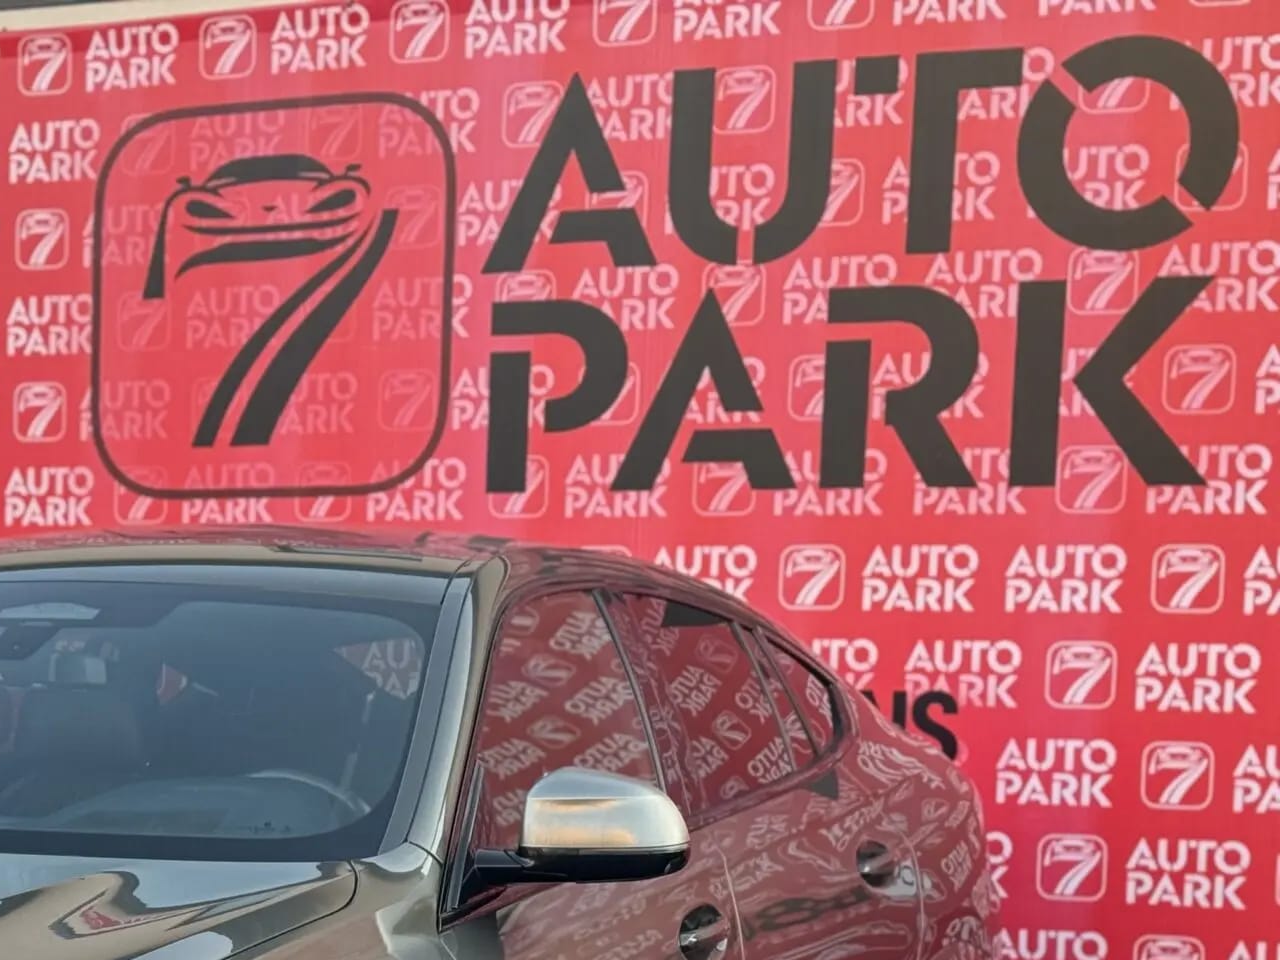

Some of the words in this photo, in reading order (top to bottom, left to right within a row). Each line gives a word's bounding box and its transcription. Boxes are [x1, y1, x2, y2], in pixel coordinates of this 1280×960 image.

[271, 4, 369, 42] AUTO
[464, 19, 567, 59] PARK
[673, 2, 780, 43] PARK
[85, 24, 178, 60] AUTO
[271, 36, 365, 73] PARK
[86, 55, 176, 92] PARK
[9, 119, 100, 152] AUTO
[9, 149, 98, 184] PARK
[480, 34, 1240, 274] AUTO
[783, 255, 897, 288] AUTO
[925, 249, 1042, 284] AUTO
[1157, 240, 1280, 277] AUTO
[572, 264, 679, 298] AUTO
[8, 294, 93, 329] AUTO
[6, 324, 92, 358] PARK
[486, 275, 1217, 493] PARK
[5, 466, 94, 499] AUTO
[914, 483, 1027, 515] PARK
[1146, 483, 1267, 515] PARK
[4, 495, 92, 528] PARK
[181, 496, 272, 526] PARK
[366, 491, 464, 523] PARK
[564, 488, 667, 518] PARK
[773, 486, 883, 515] PARK
[654, 544, 757, 577] AUTO
[862, 544, 979, 578] AUTO
[1004, 544, 1127, 578] AUTO
[862, 577, 975, 612] PARK
[1004, 578, 1123, 613] PARK
[905, 640, 1021, 674] AUTO
[1136, 643, 1262, 680] AUTO
[1136, 678, 1258, 715] PARK
[995, 739, 1118, 773] AUTO
[995, 770, 1113, 809] PARK
[1126, 837, 1250, 875] AUTO
[1125, 872, 1246, 909] PARK
